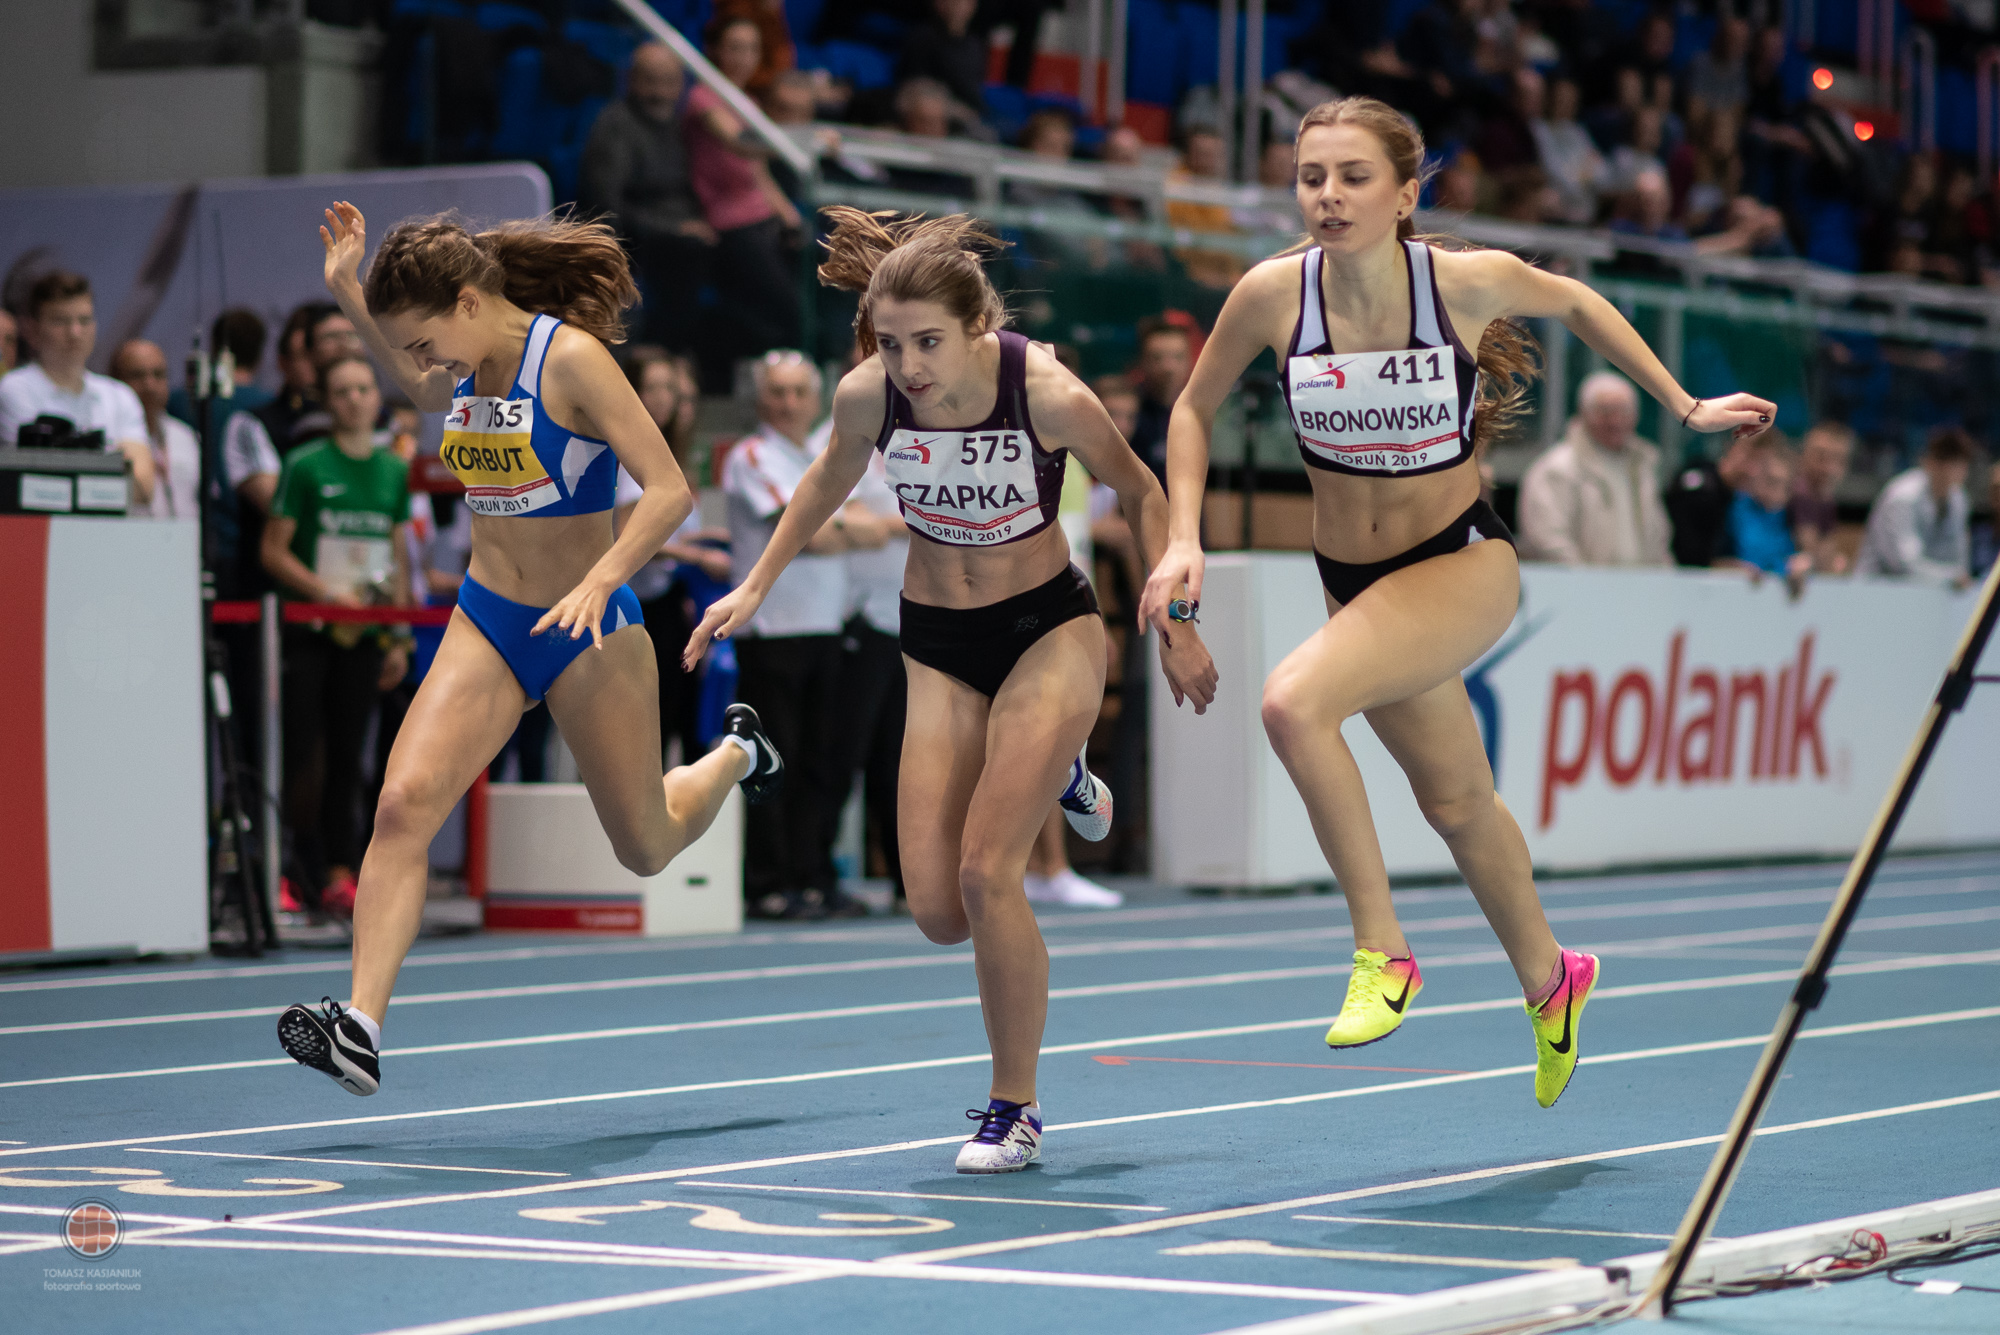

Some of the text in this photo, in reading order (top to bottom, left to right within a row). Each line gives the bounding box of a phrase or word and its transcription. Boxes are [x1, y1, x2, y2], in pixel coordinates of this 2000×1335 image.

[1378, 352, 1445, 385] 411
[1299, 402, 1452, 433] BRONOWSKA
[443, 444, 525, 473] KORBUT
[960, 434, 1021, 465] 575
[1332, 451, 1428, 467] TORUŃ 2019
[471, 496, 529, 512] ORUŃ 2019
[895, 482, 1027, 510] CZAPKA
[924, 522, 1012, 542] TORUŃ 2019
